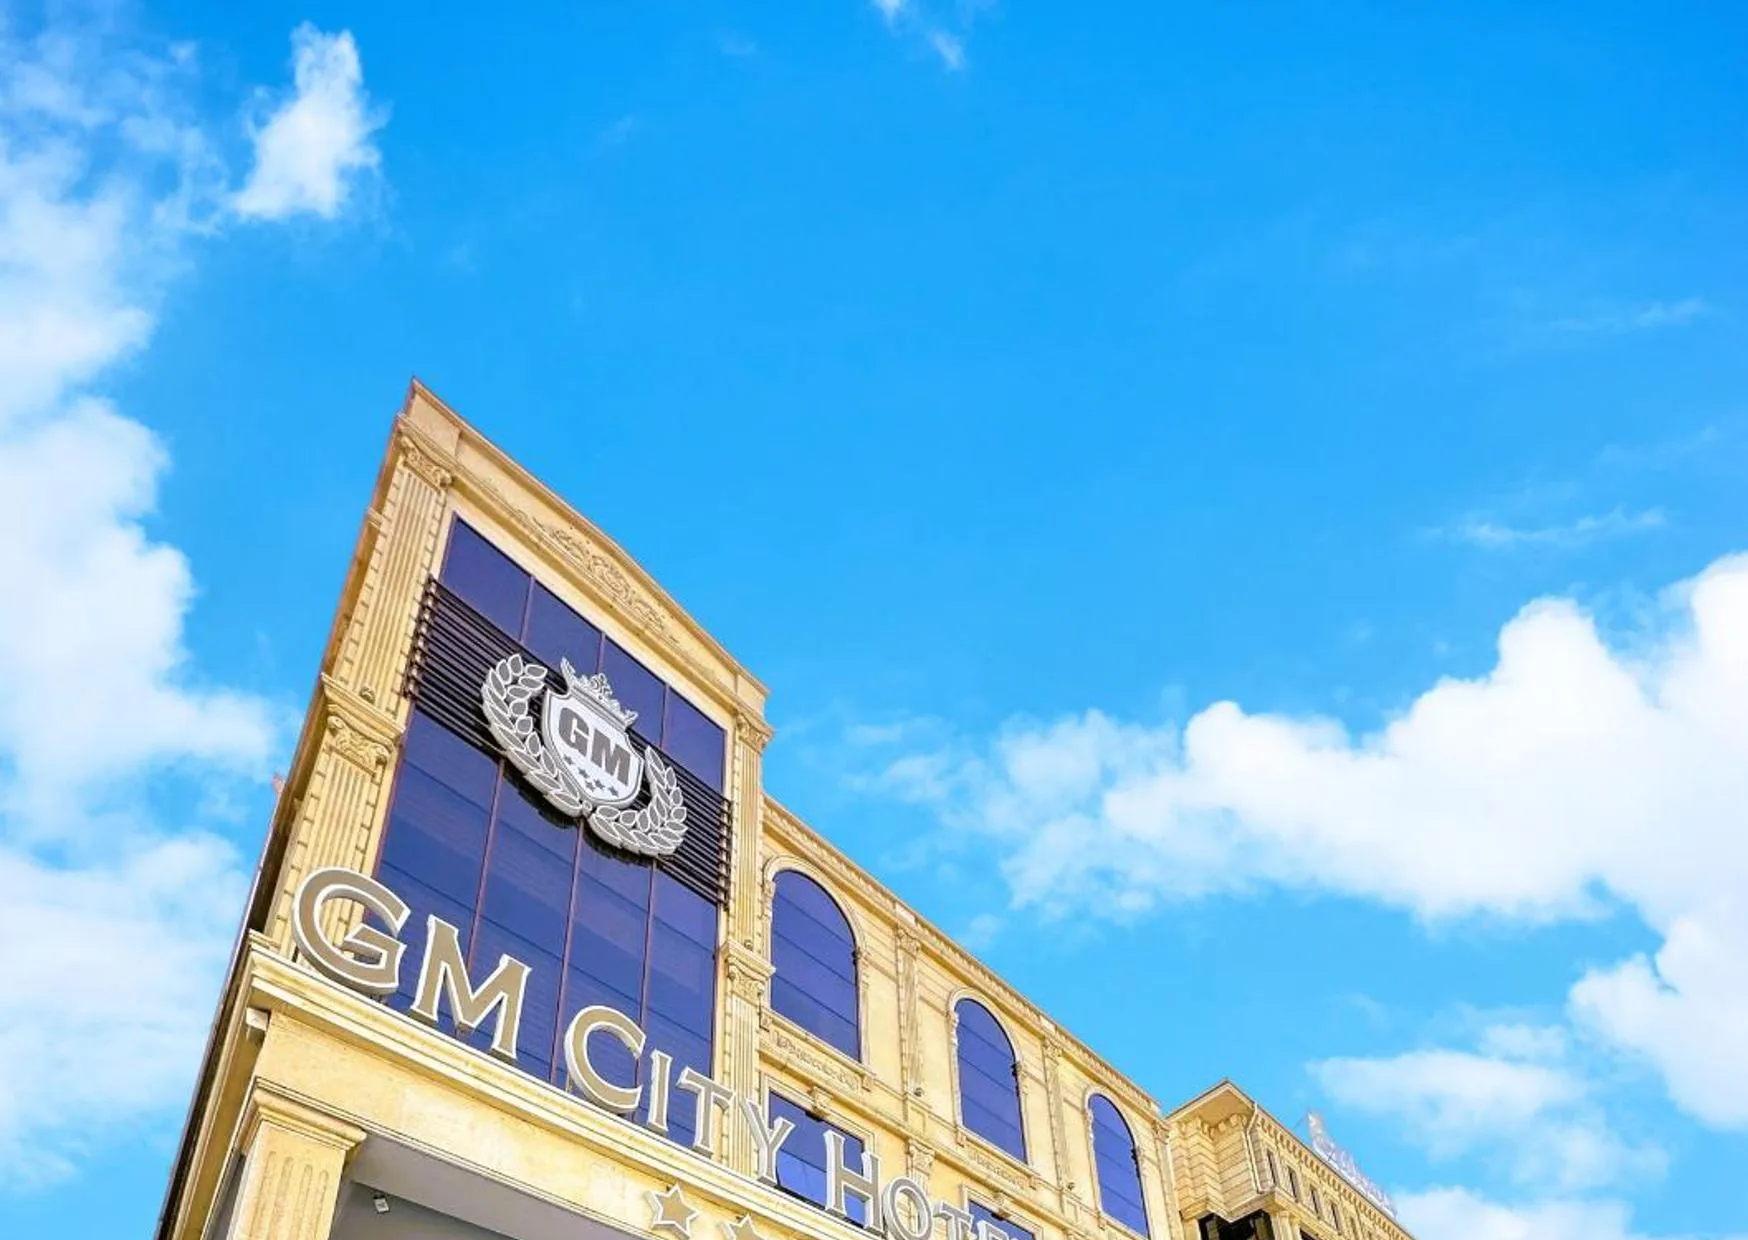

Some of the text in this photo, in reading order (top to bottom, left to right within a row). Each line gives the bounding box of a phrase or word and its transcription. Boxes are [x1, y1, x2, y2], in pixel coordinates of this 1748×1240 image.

[559, 707, 631, 786] GM
[292, 867, 532, 1062] GM
[565, 1005, 796, 1186] CITY
